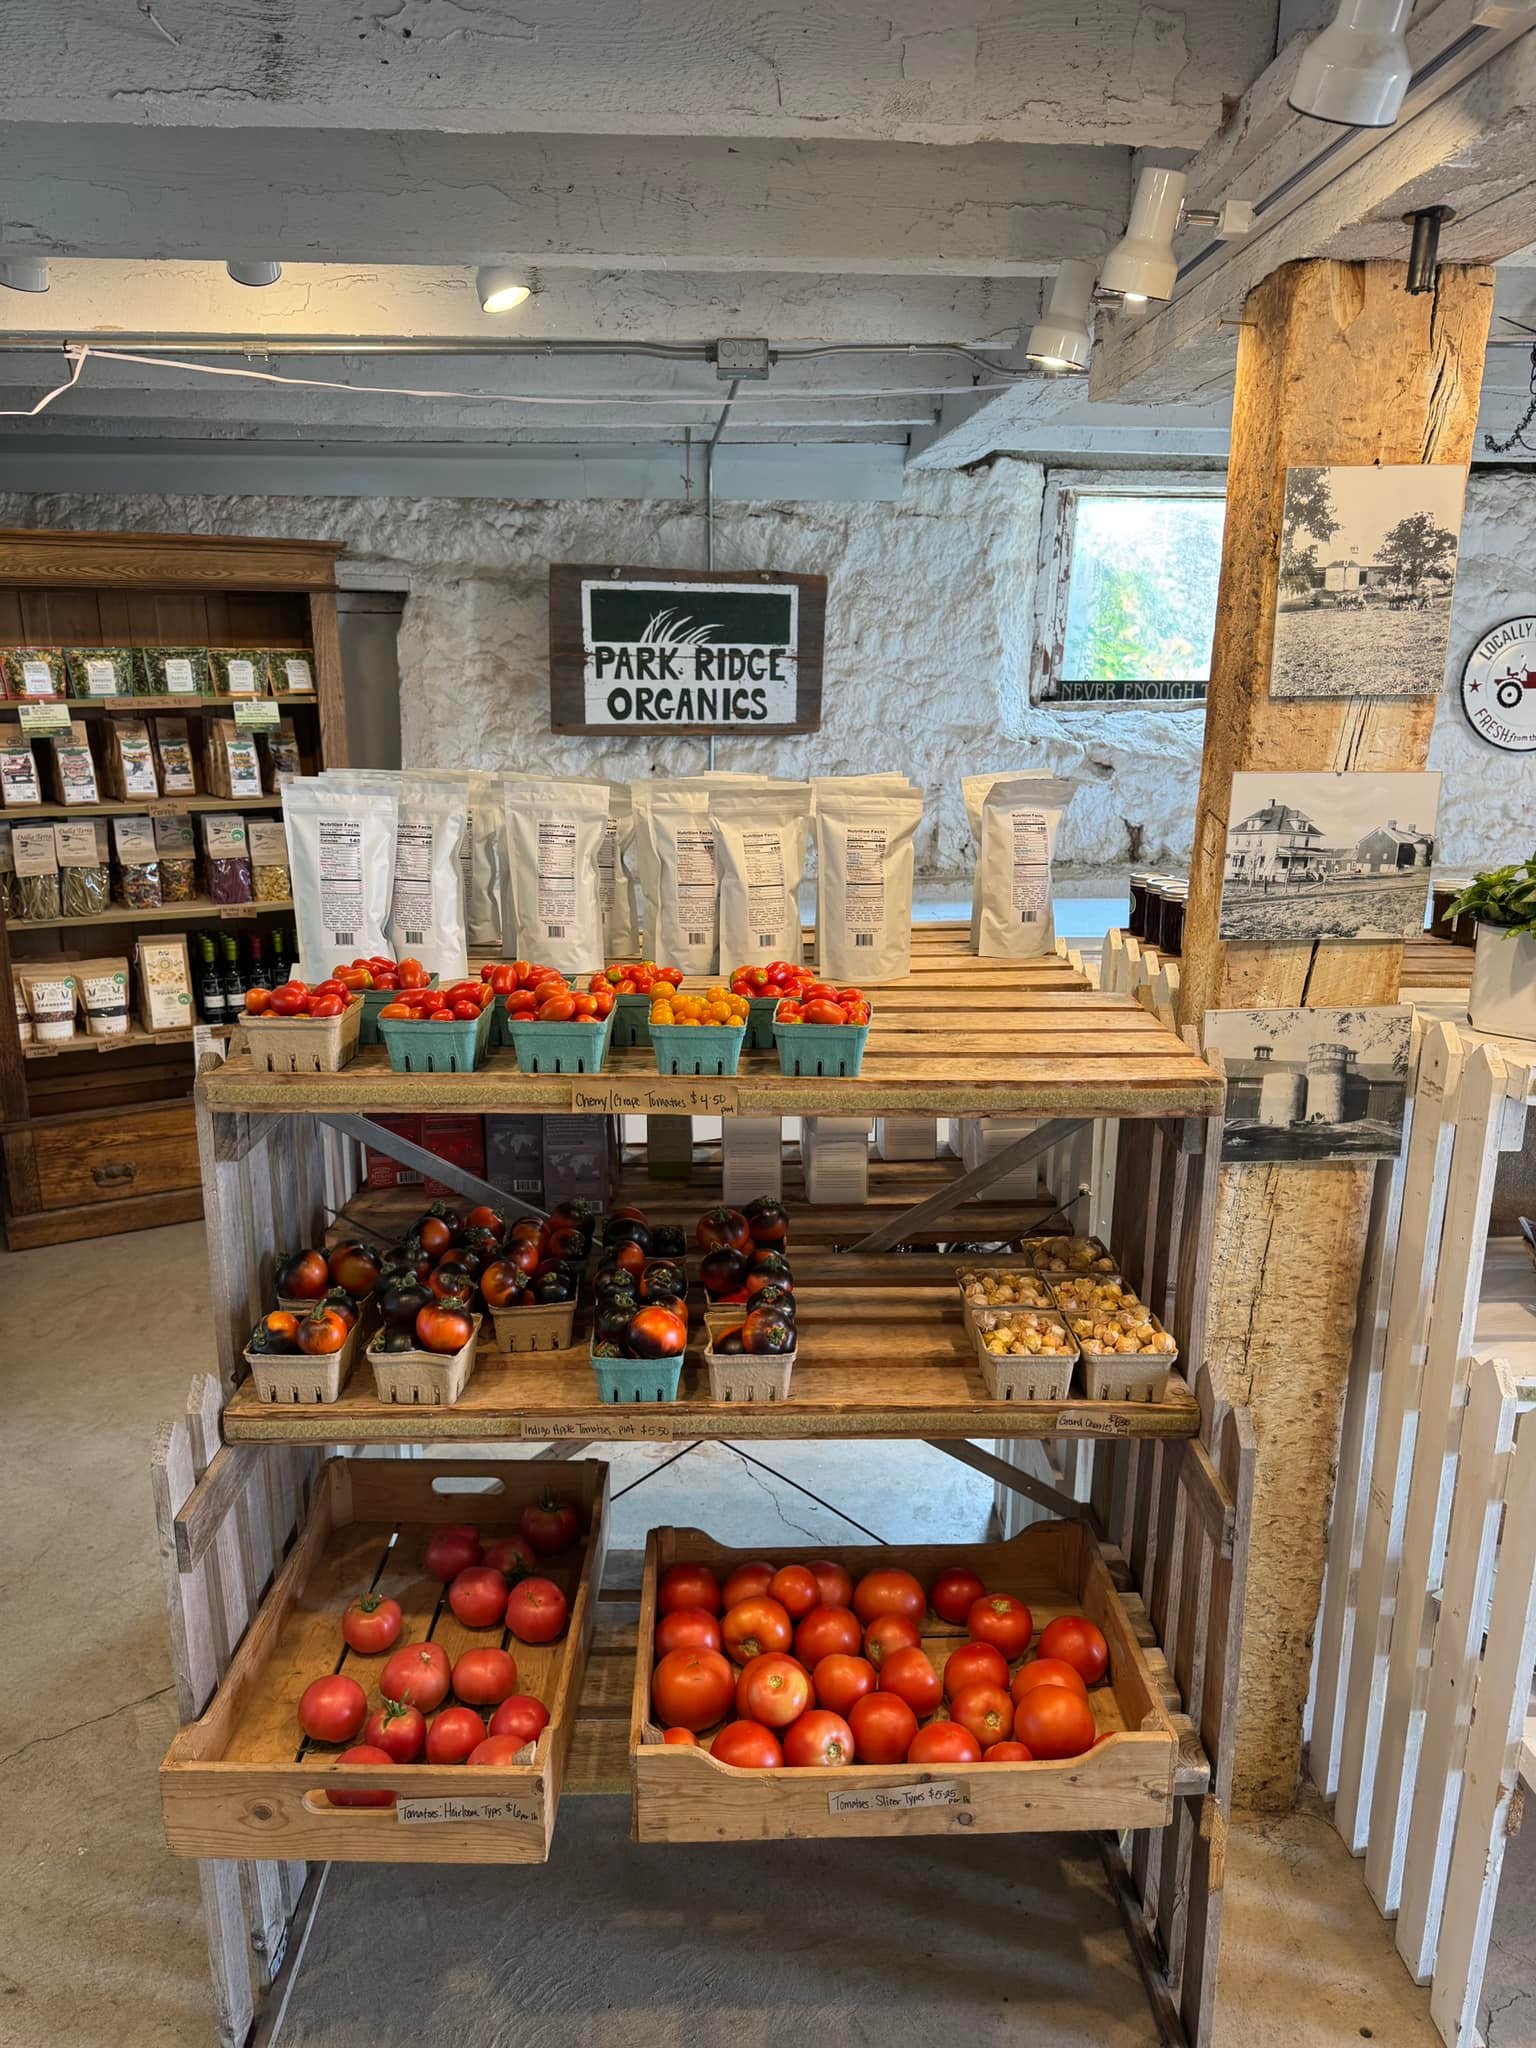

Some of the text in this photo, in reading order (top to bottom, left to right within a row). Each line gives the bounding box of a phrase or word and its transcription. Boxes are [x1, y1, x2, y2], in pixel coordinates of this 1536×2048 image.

[1479, 622, 1533, 661] LOCALLY
[594, 646, 787, 681] PARK RIDGE
[607, 687, 768, 721] ORGANICS
[1061, 682, 1116, 700] NEVER
[1123, 683, 1195, 700] ENOUGH
[1474, 708, 1510, 743] FRESH
